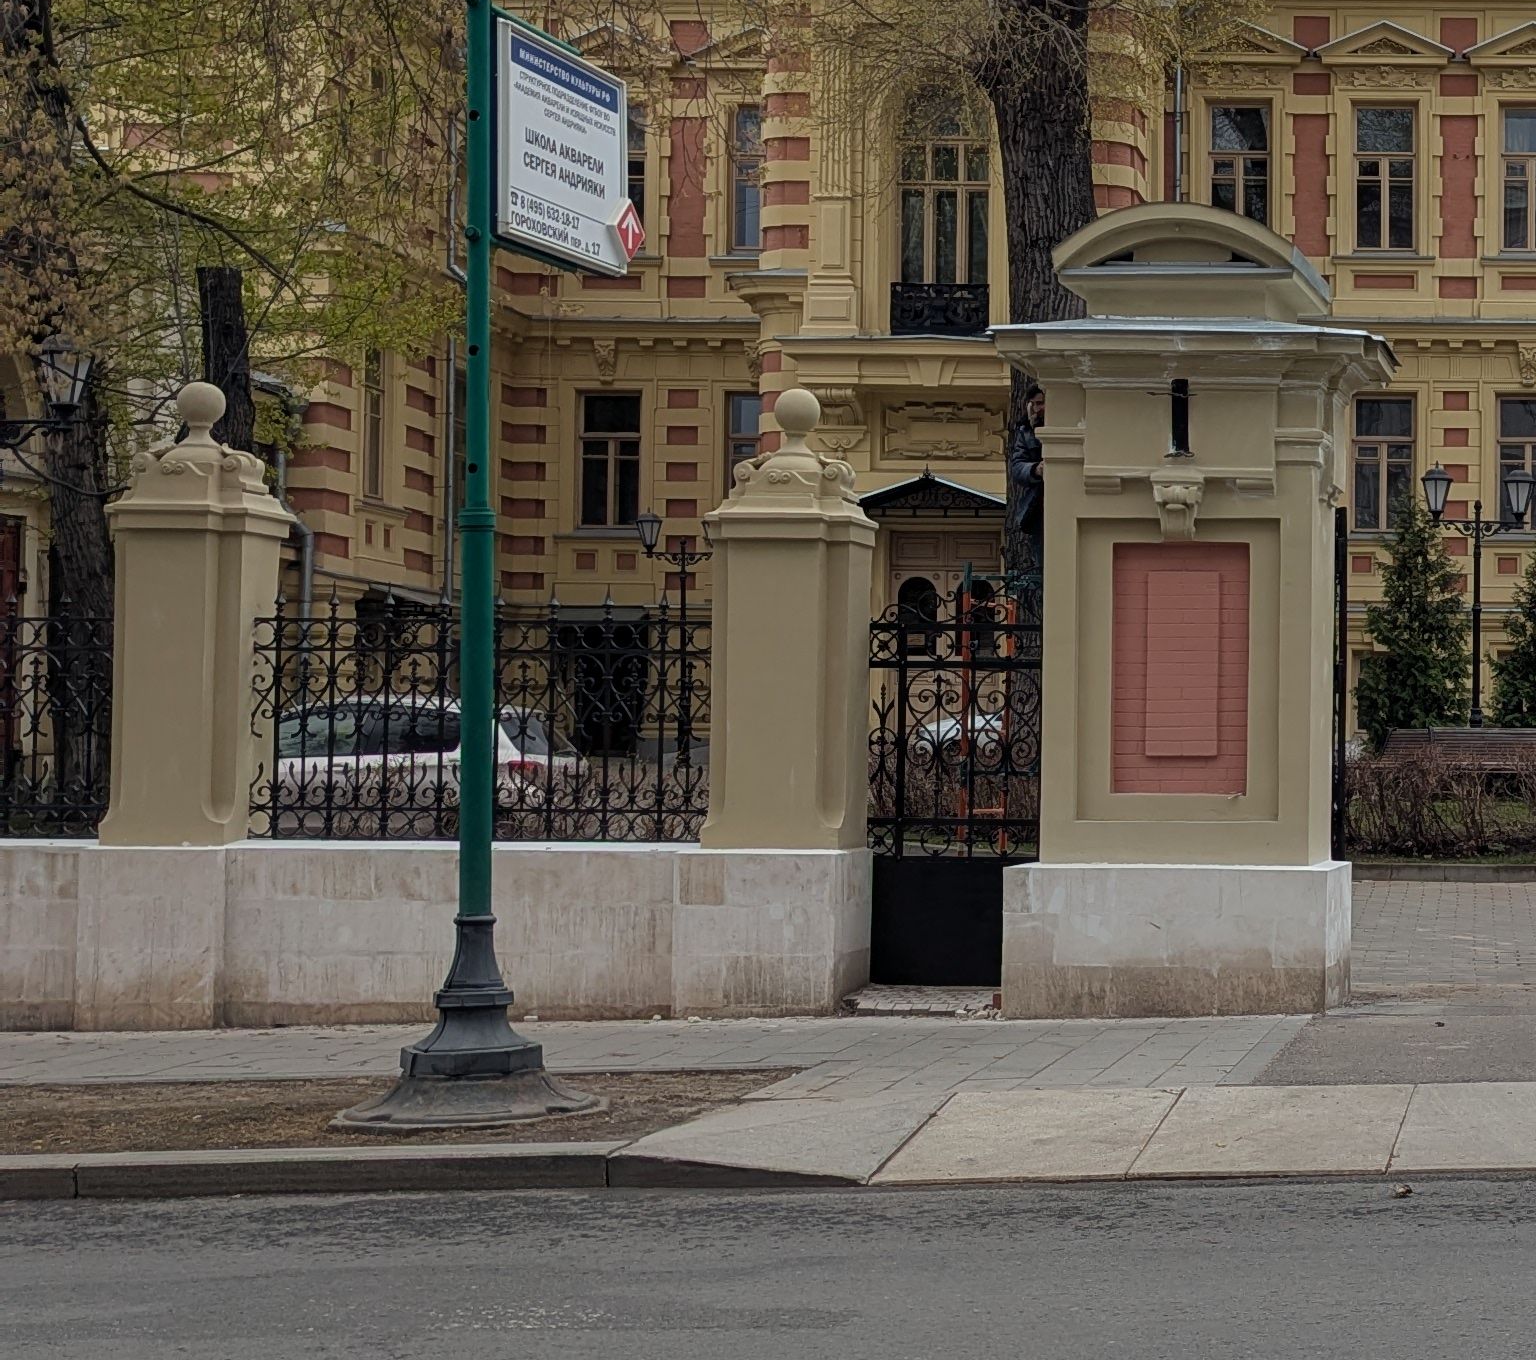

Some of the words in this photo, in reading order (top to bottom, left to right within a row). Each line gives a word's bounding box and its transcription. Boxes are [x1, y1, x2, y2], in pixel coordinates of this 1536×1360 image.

[519, 47, 570, 83] МИНИСТЕРСТВО
[570, 74, 601, 98] КУЛЬТУРЫ
[601, 90, 611, 103] РФ
[523, 151, 557, 179] СЕРГЕЯ
[558, 166, 606, 199] АНДРИЯКИ
[525, 126, 557, 155] ШКОЛА
[559, 143, 604, 176] АКВАРЕЛИ
[511, 210, 569, 245] ГОРОХОВСКИЙ
[591, 241, 601, 256] 17
[520, 195, 526, 210] 8
[527, 197, 545, 220] (495)
[546, 205, 580, 230] 632-18-17
